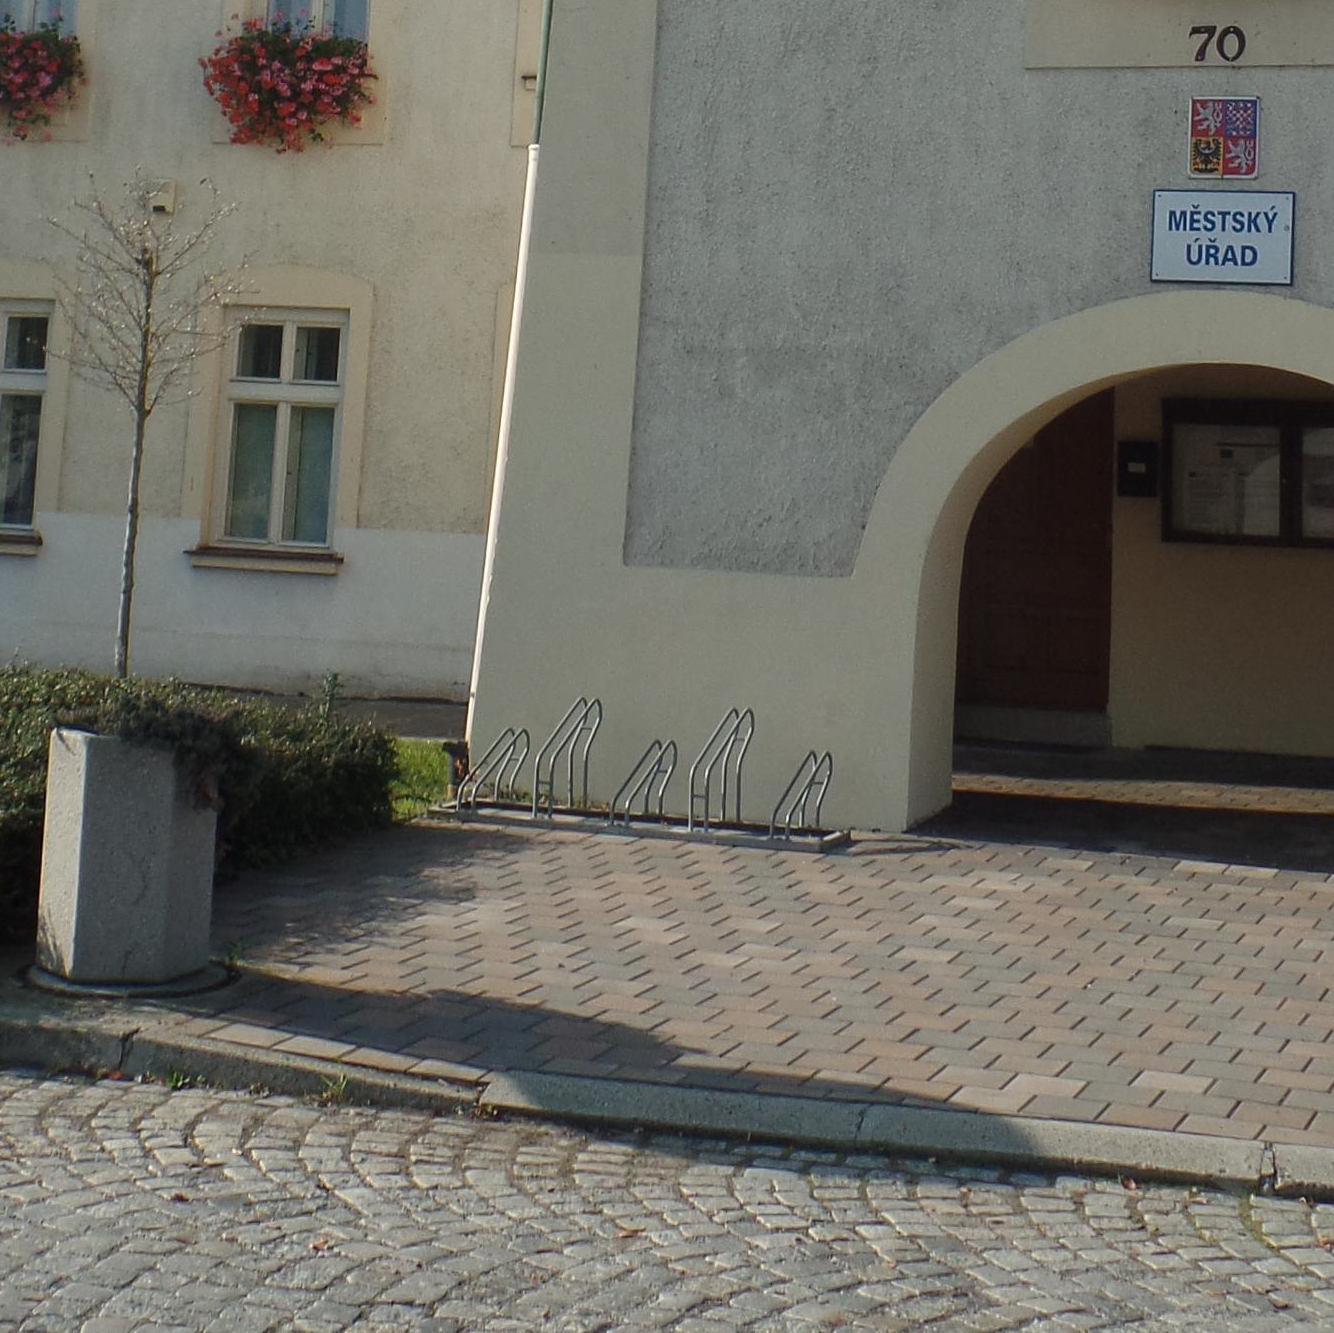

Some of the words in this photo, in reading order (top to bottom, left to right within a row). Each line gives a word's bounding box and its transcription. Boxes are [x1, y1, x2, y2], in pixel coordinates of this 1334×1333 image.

[1188, 25, 1246, 62] 70
[1168, 204, 1279, 234] MĚSTSKÝ
[1186, 238, 1259, 268] ÚŘAD
